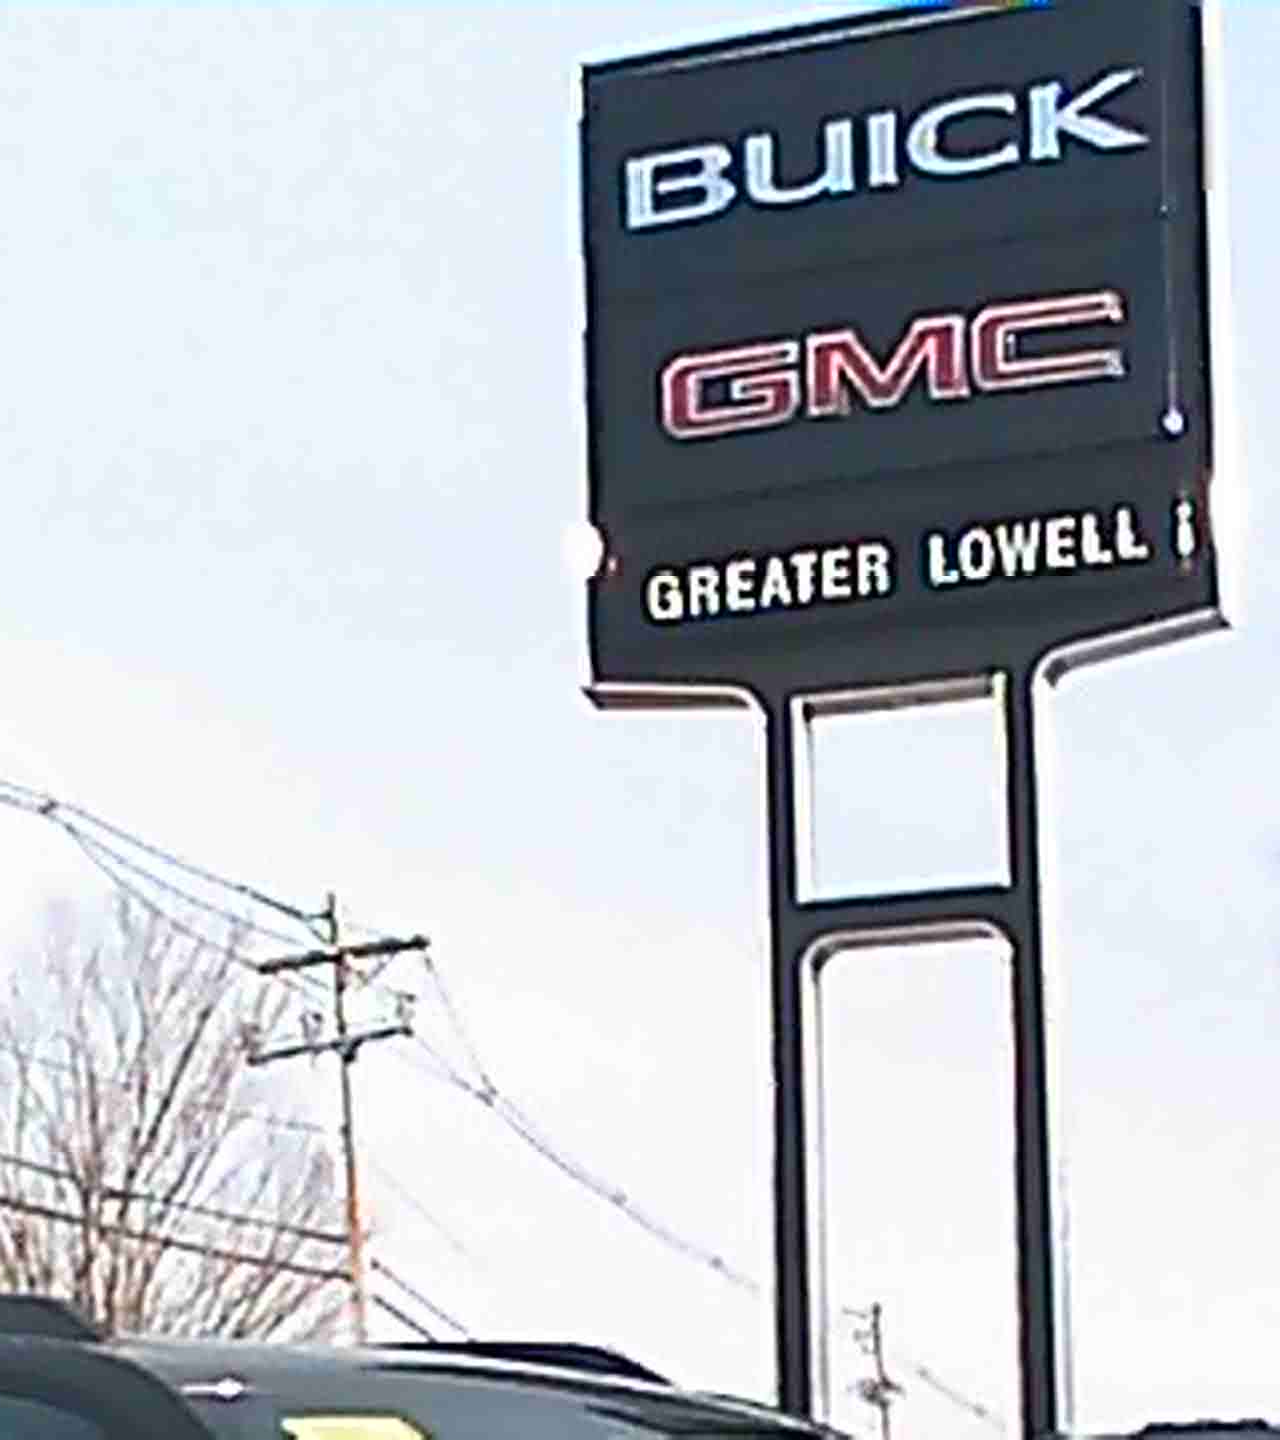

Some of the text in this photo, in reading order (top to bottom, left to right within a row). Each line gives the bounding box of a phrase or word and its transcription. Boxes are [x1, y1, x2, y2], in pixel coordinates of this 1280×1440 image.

[624, 67, 1150, 230] BUICK
[661, 291, 1124, 439] GMC
[646, 506, 1150, 621] GREATER LOWELL
